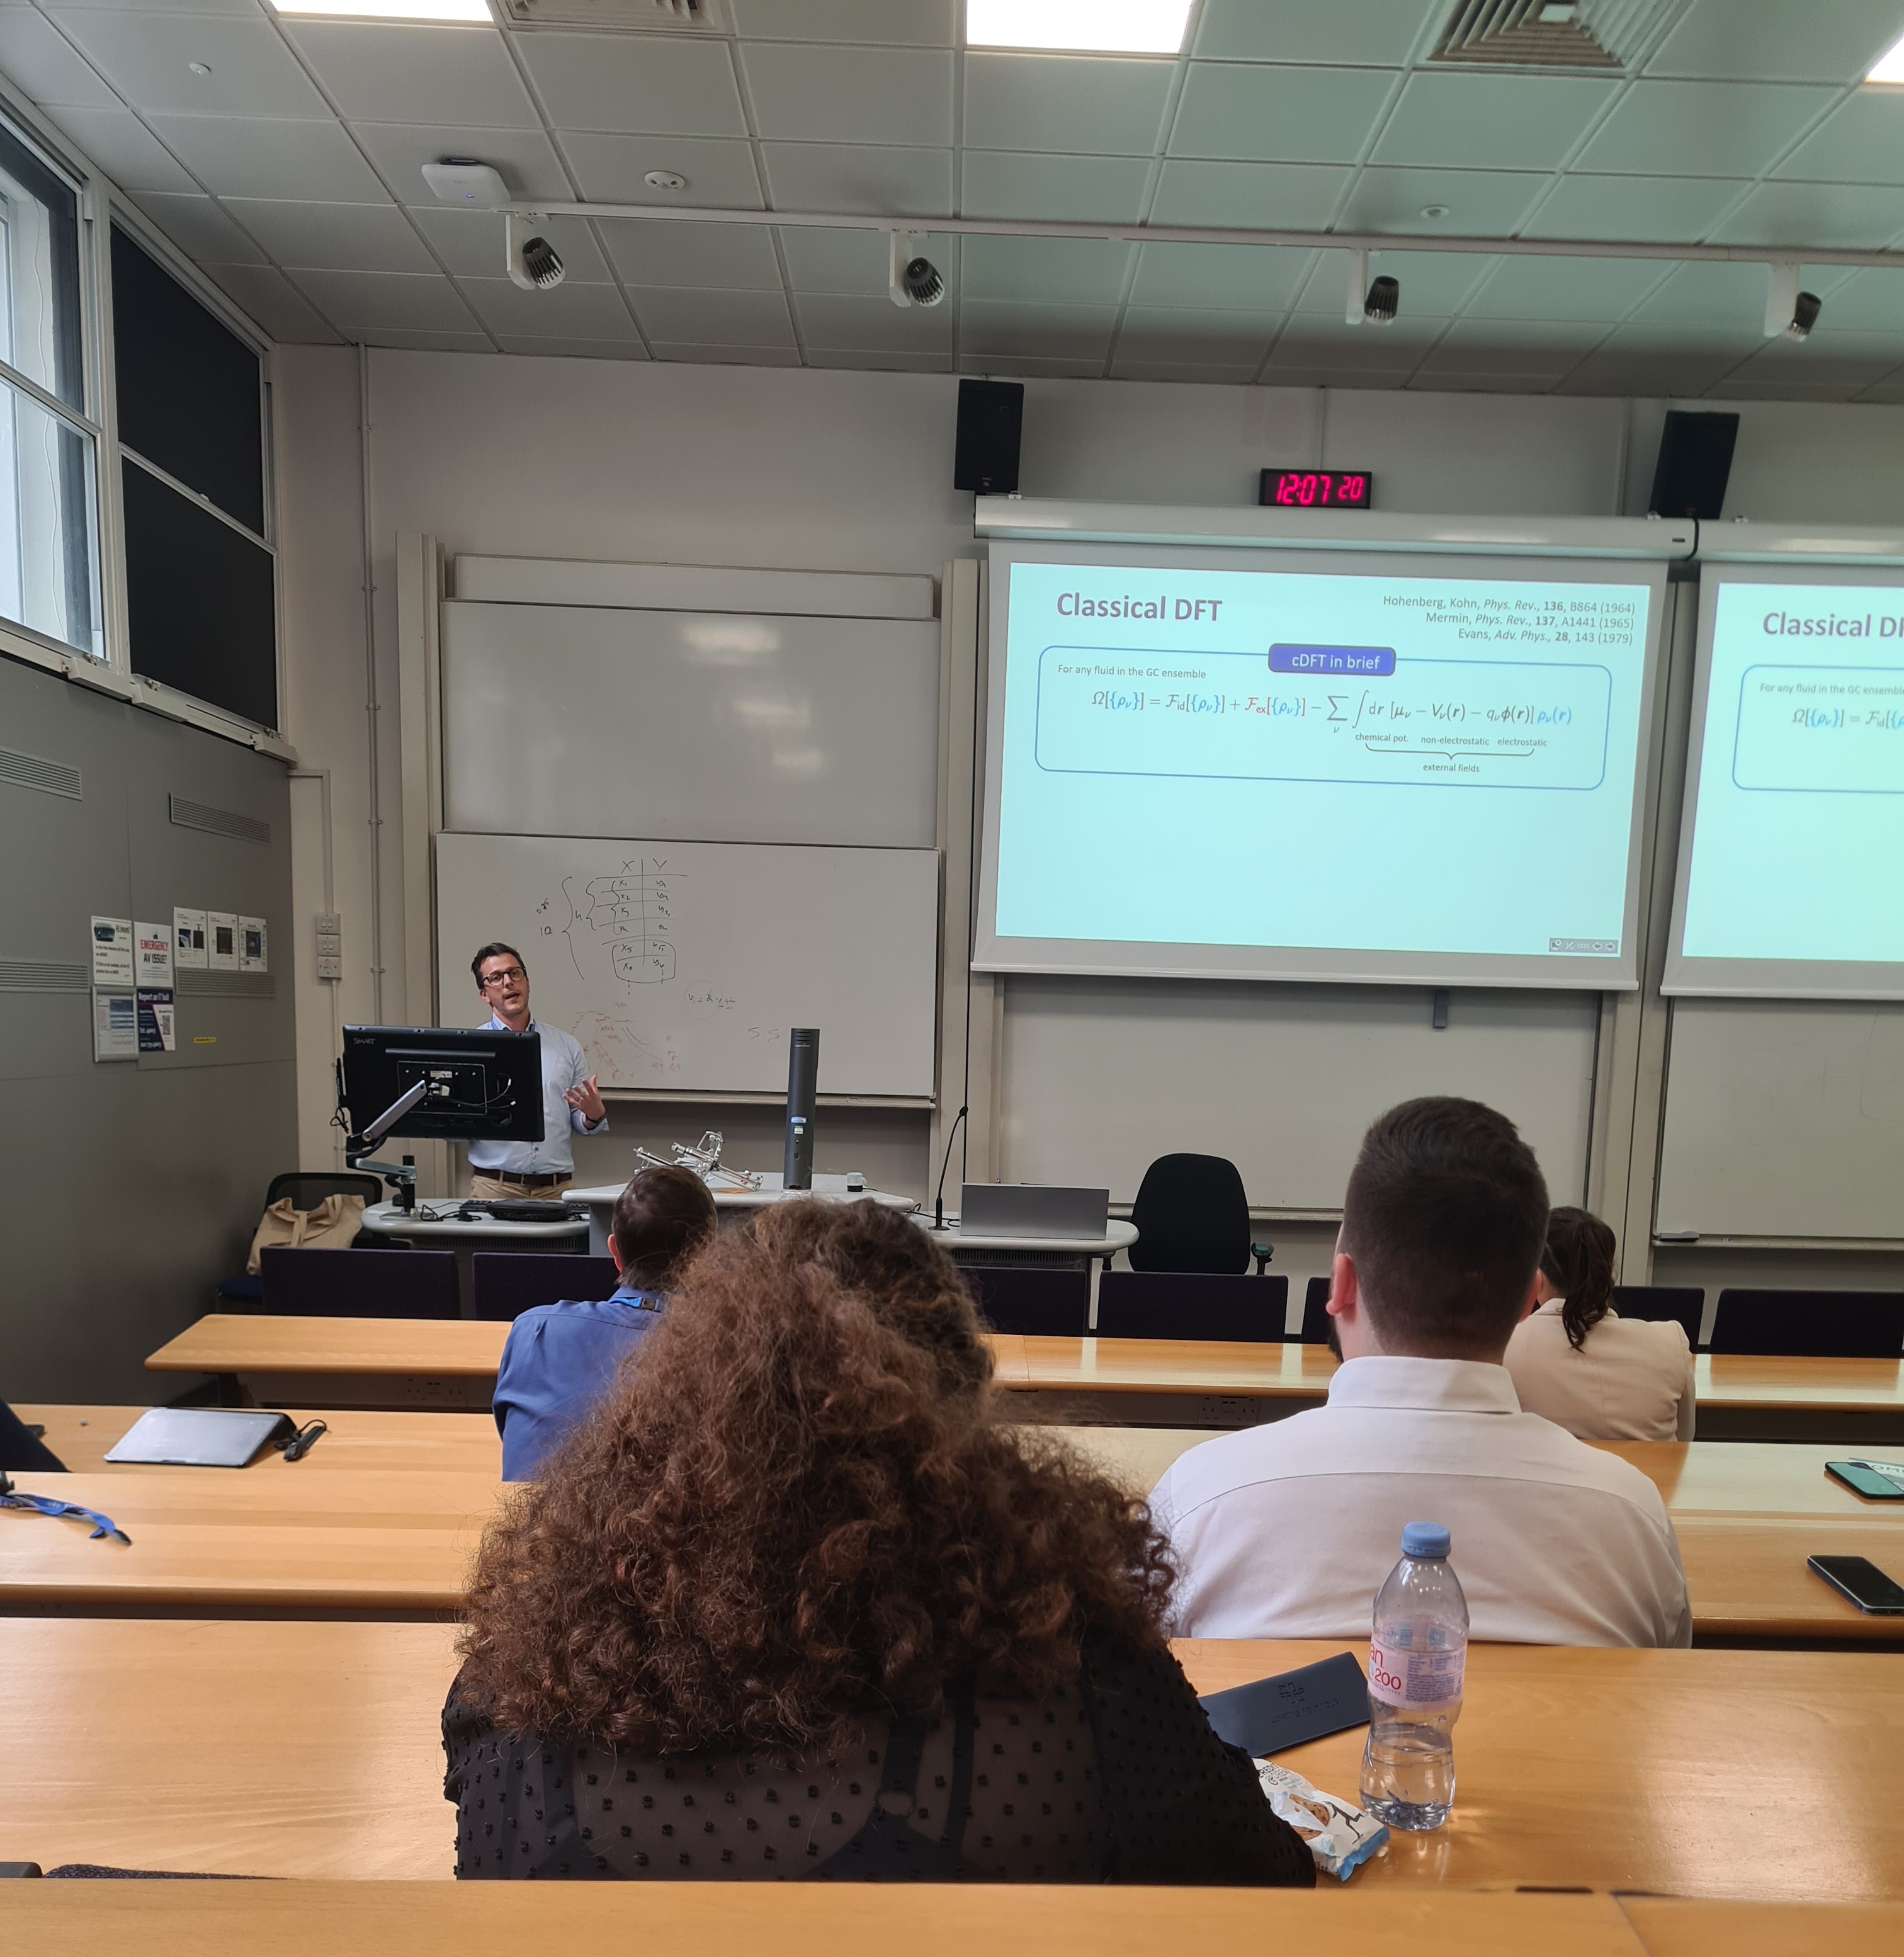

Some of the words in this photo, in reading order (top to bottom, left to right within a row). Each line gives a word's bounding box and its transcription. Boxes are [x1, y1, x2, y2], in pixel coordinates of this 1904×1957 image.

[1276, 474, 1332, 506] 12:07
[1337, 475, 1364, 500] 20
[1057, 592, 1165, 619] Classical
[1175, 598, 1223, 621] DFT
[1383, 596, 1446, 609] Hohenberg,
[1449, 598, 1480, 610] Kohn,
[1483, 599, 1511, 611] Phys.
[1514, 600, 1541, 612] Rev.,
[1543, 601, 1567, 613] 136,
[1570, 602, 1597, 612] B864
[1601, 602, 1636, 615] (1964)
[1425, 612, 1472, 625] Mermin,
[1475, 614, 1502, 627] Phys.
[1506, 615, 1531, 627] Rev.,
[1535, 616, 1558, 628] 137,
[1561, 617, 1596, 628] A1441
[1599, 617, 1634, 630] (1965)
[1763, 611, 1872, 637] Classical
[1458, 628, 1492, 641] Evans,
[1494, 630, 1517, 640] Adv.
[1521, 630, 1551, 643] Phys.,
[1555, 632, 1571, 643] 28,
[1575, 632, 1595, 643] 143
[1598, 633, 1633, 645] (1979)
[1291, 654, 1327, 669] cDFT
[1330, 654, 1342, 669] in
[1347, 654, 1381, 670] brief
[1058, 665, 1073, 674] For
[1075, 667, 1092, 676] any
[1094, 665, 1114, 676] fluid
[1116, 667, 1126, 676] in
[1128, 667, 1143, 676] the
[1146, 668, 1159, 678] GC
[1161, 669, 1206, 679] ensemble
[1760, 683, 1775, 692] For
[1778, 684, 1794, 695] any
[1796, 683, 1816, 693] fluid
[1818, 684, 1827, 693] in
[1830, 684, 1845, 693] the
[1847, 685, 1861, 694] GC
[1356, 732, 1391, 742] chemical
[1393, 734, 1409, 744] pot.
[1420, 735, 1490, 746] non-electrostatic
[1497, 737, 1548, 747] electrostatic
[1423, 763, 1456, 772] external
[1458, 764, 1480, 773] fields
[144, 953, 150, 963] AV
[1374, 1668, 1402, 1690] 200
